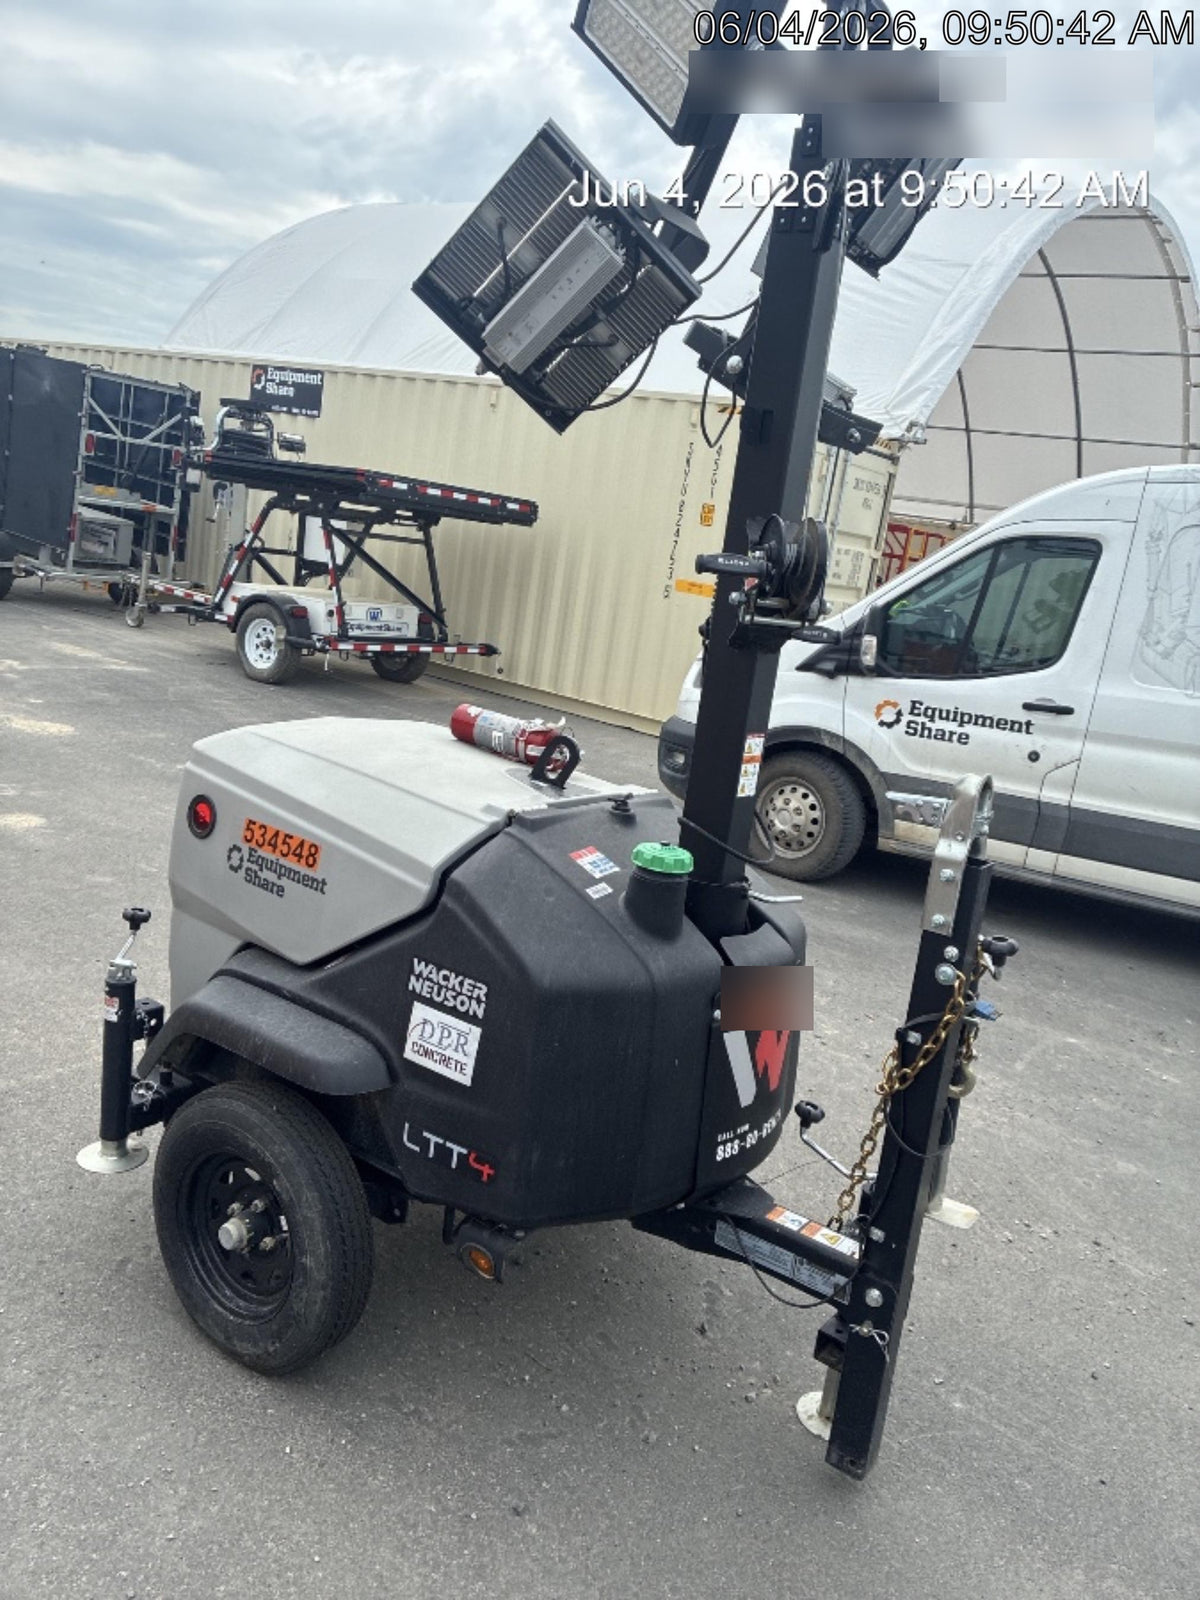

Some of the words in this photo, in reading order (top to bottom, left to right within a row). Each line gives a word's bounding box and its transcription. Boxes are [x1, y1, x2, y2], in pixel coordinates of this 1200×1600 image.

[266, 381, 295, 397] Share
[267, 367, 322, 385] Equipment
[905, 719, 970, 745] Share
[908, 700, 1035, 734] Equipment
[244, 819, 319, 868] 534548
[243, 866, 285, 898] Share
[246, 846, 327, 895] Equipment
[408, 974, 486, 1020] NEUSON
[413, 957, 488, 1002] WACKER
[418, 1018, 470, 1057] DPR
[411, 1041, 468, 1076] CONCRETE
[402, 1121, 495, 1182] LTT4
